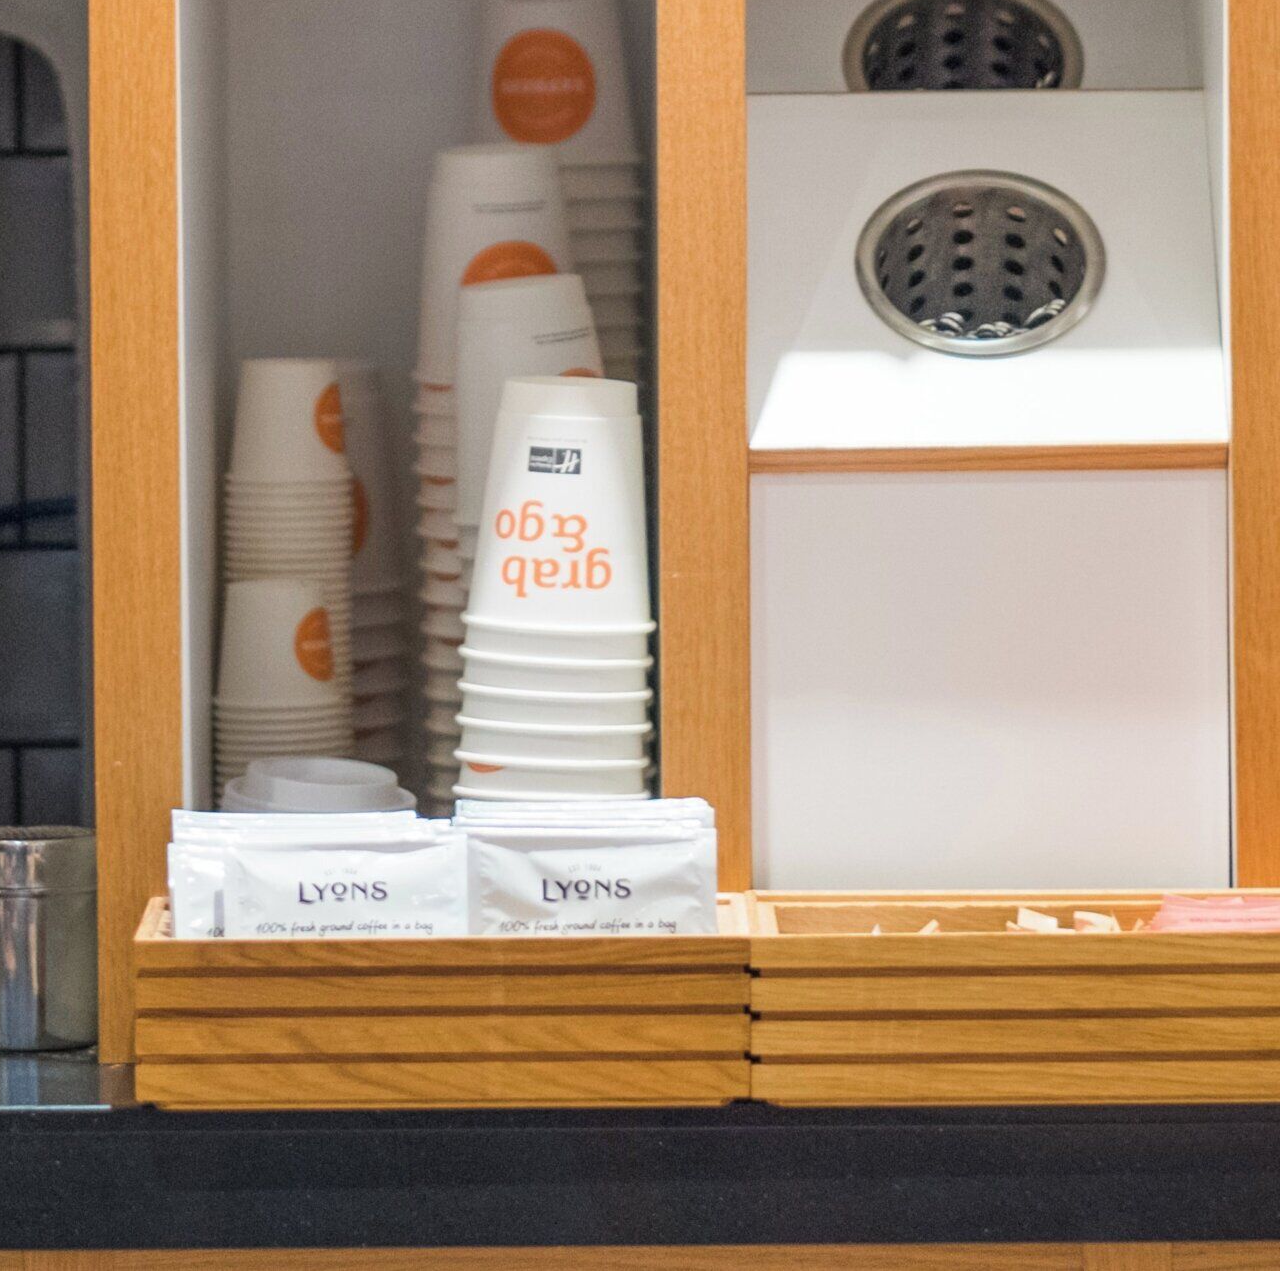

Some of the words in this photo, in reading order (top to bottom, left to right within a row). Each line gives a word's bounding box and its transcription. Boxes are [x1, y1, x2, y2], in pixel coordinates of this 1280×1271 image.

[495, 500, 545, 542] go
[552, 513, 588, 553] &
[501, 547, 612, 598] grab
[298, 880, 388, 904] LYONS
[542, 879, 632, 902] LYONS
[255, 921, 287, 934] 100%
[291, 921, 315, 937] fresh
[320, 920, 354, 937] ground
[357, 919, 387, 936] coffee
[415, 921, 433, 935] bag
[498, 920, 530, 933] 100%
[534, 919, 559, 934] fresh
[562, 918, 596, 935] ground
[599, 917, 630, 933] coffee
[658, 919, 677, 934] bag
